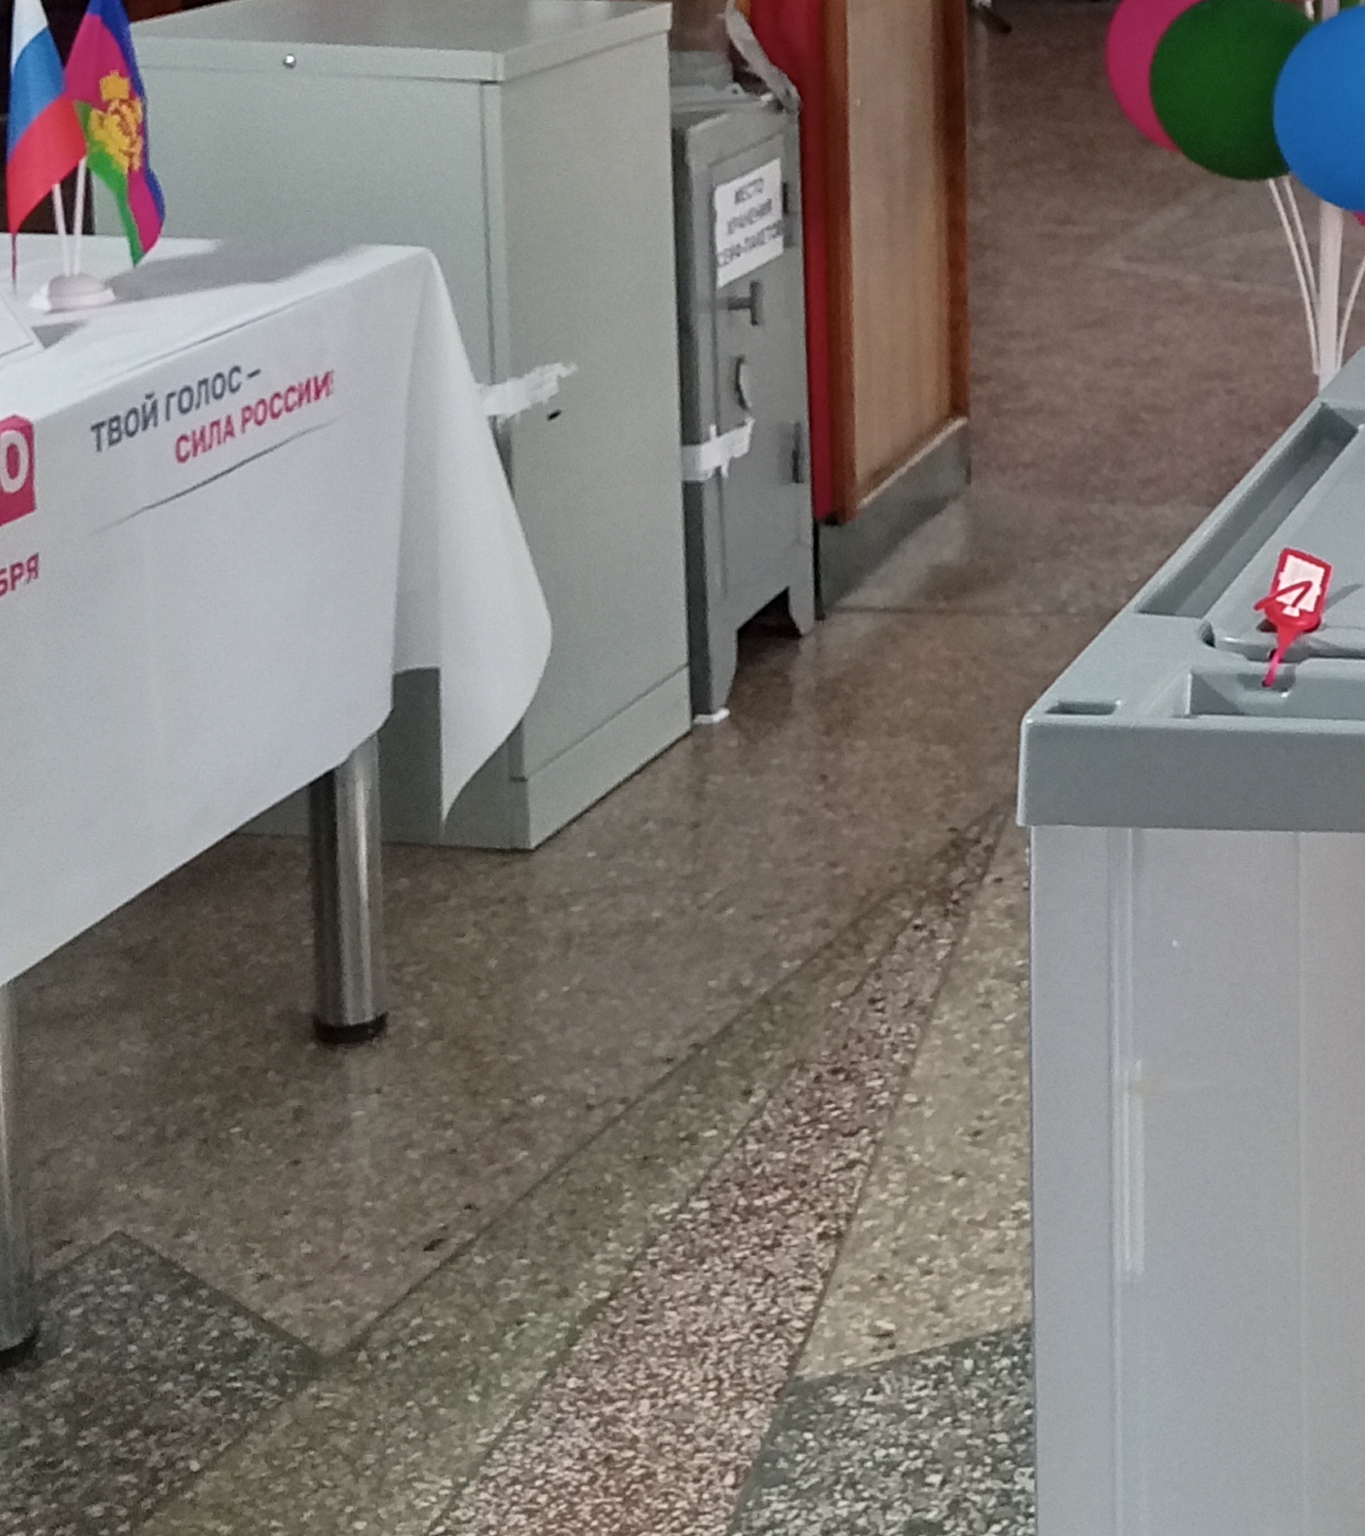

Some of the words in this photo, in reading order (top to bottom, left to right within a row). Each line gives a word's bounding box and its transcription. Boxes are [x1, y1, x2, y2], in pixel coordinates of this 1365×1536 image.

[90, 392, 158, 453] ТВОЙ
[164, 365, 243, 421] ГОЛОС
[174, 415, 236, 463] СИЛА
